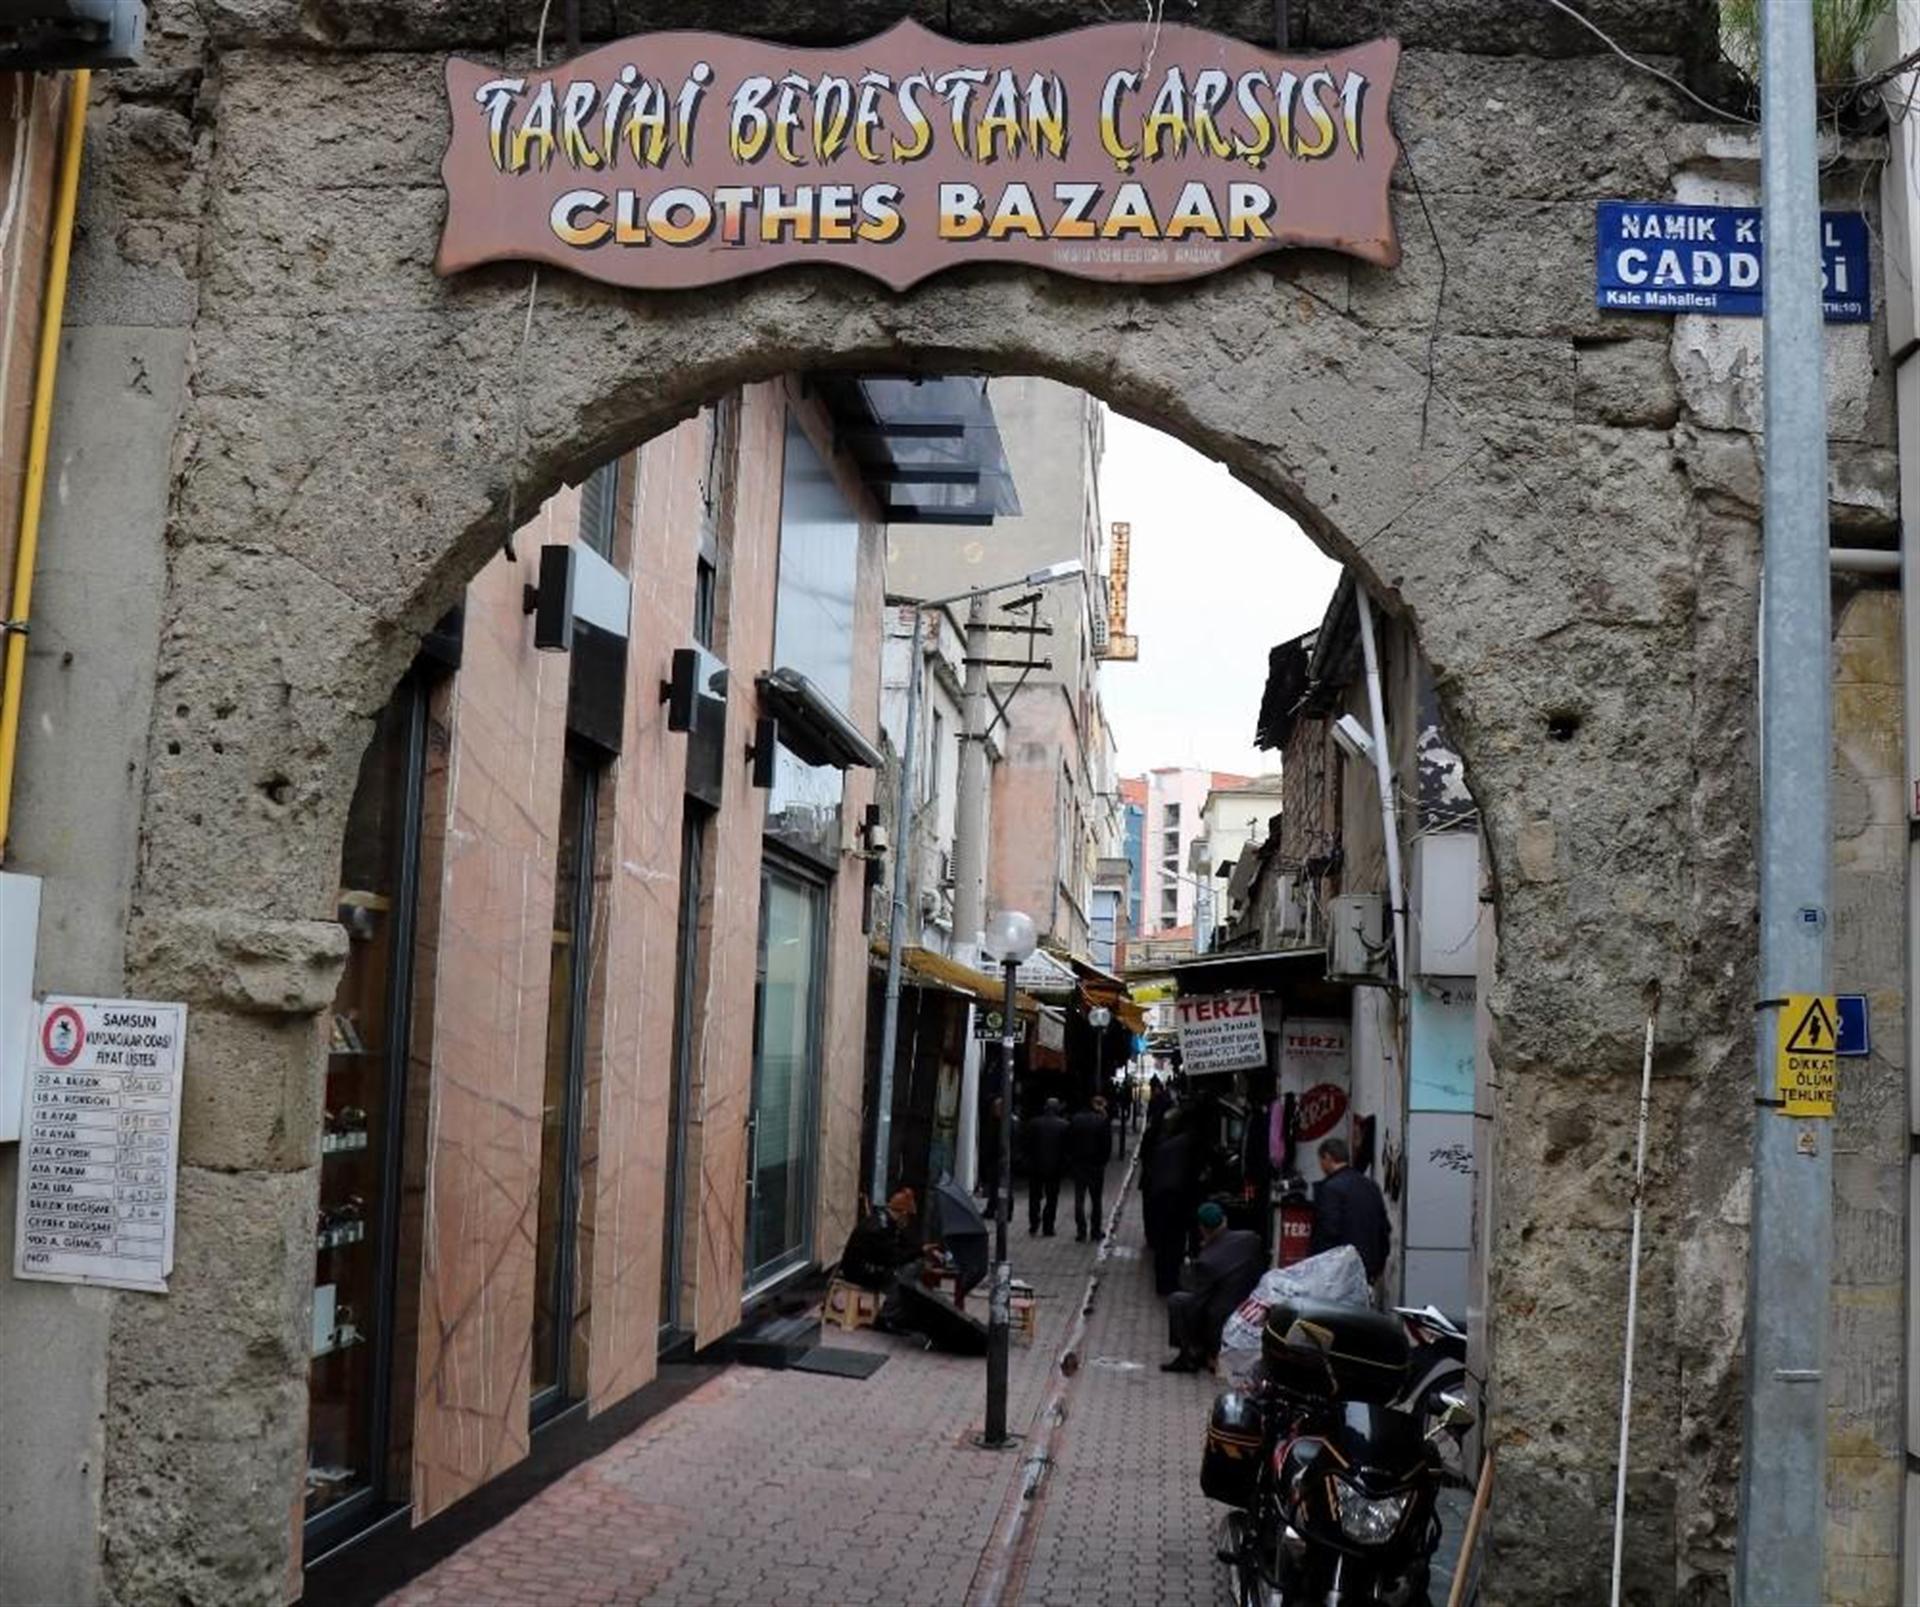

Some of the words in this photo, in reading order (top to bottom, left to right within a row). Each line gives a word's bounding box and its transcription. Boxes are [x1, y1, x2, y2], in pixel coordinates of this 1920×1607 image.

[474, 60, 714, 174] TARİHİ
[1099, 65, 1371, 173] ÇARŞISI
[548, 182, 906, 248] CLOTHES
[938, 181, 1277, 242] BAZAAR
[1621, 213, 1717, 242] NAMIK
[1606, 290, 1641, 305] Kale
[1645, 292, 1717, 307] Mahallesi
[102, 1013, 157, 1028] SAMSUN
